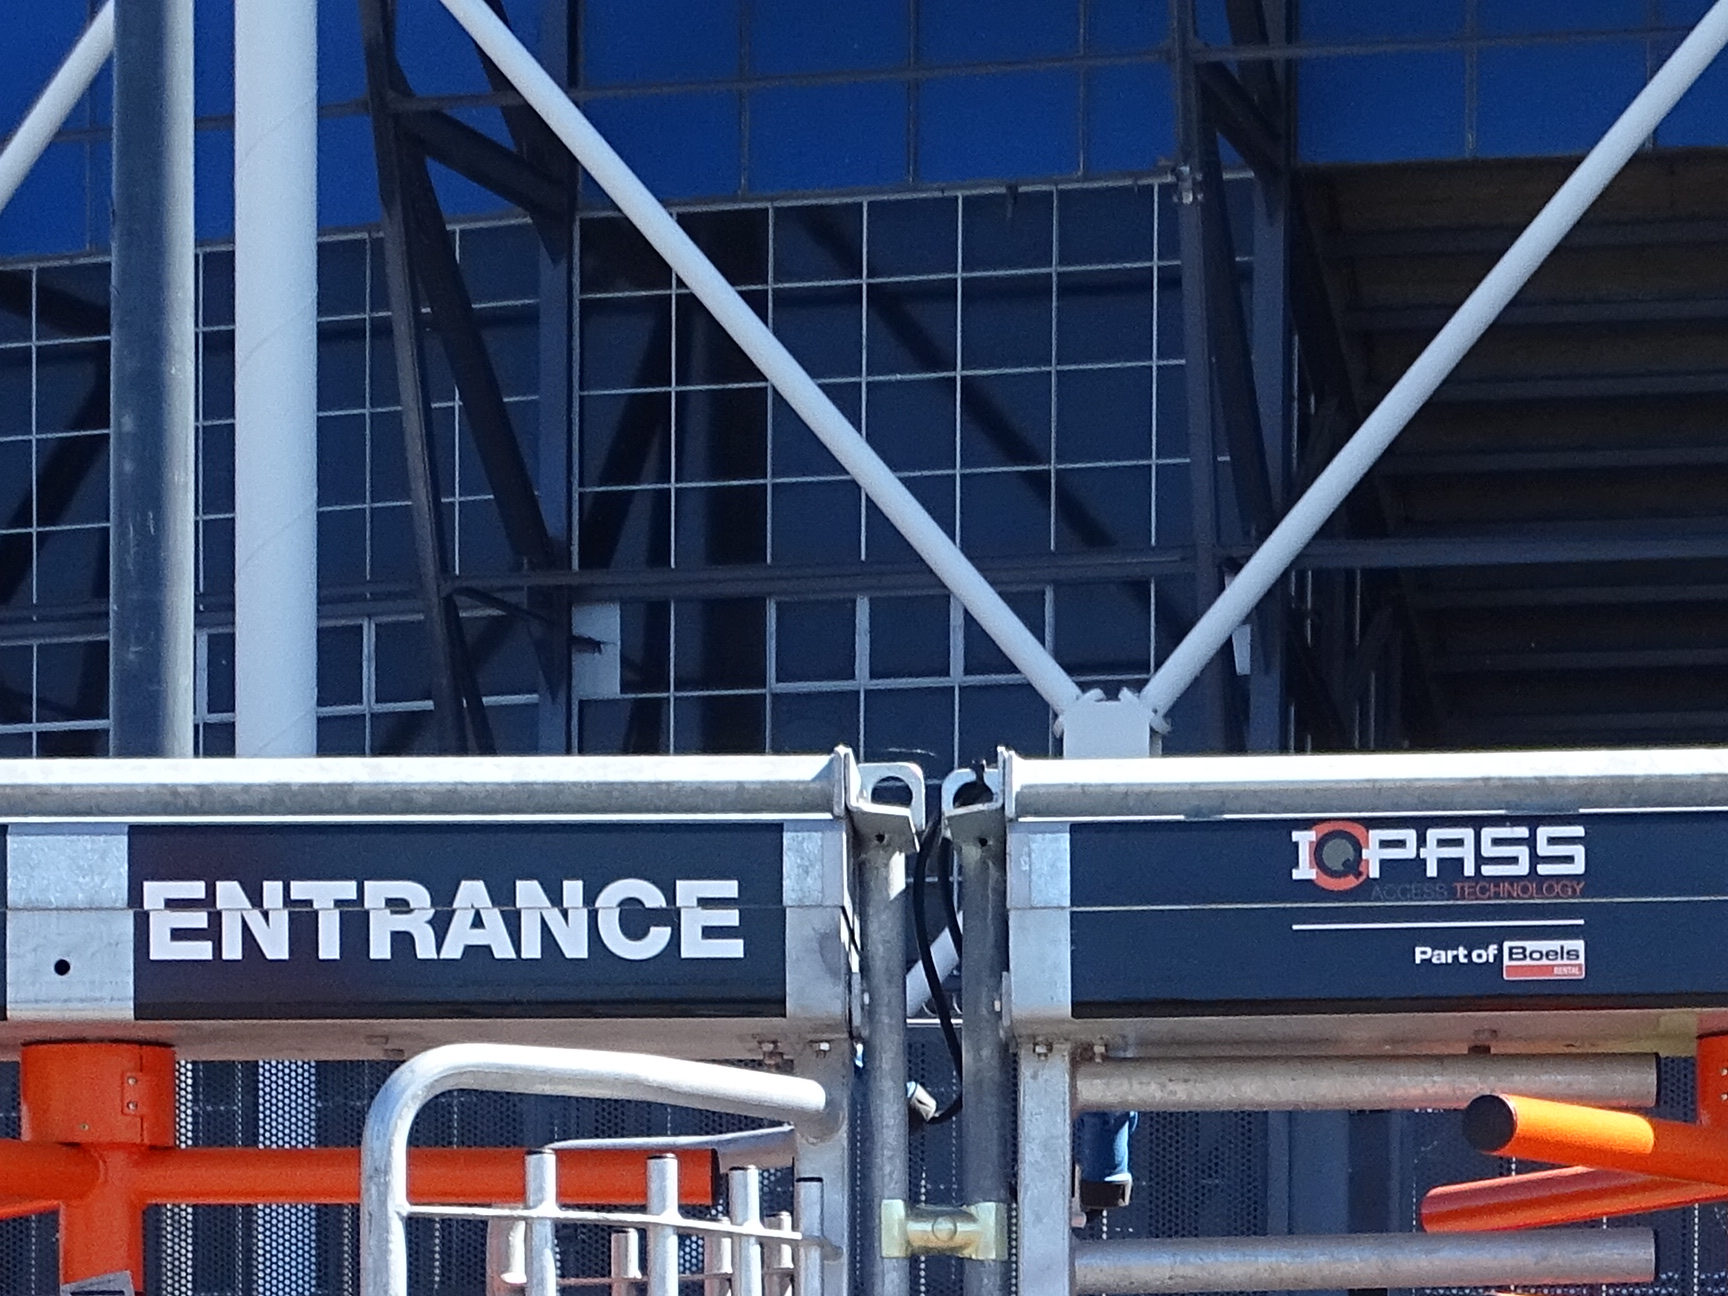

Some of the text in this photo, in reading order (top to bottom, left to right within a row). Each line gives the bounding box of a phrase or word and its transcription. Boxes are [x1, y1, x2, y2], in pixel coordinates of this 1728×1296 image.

[1452, 881, 1585, 899] TECHNOLOGY
[142, 878, 745, 960] ENTRANCE
[1415, 945, 1580, 965] Part of Boels
